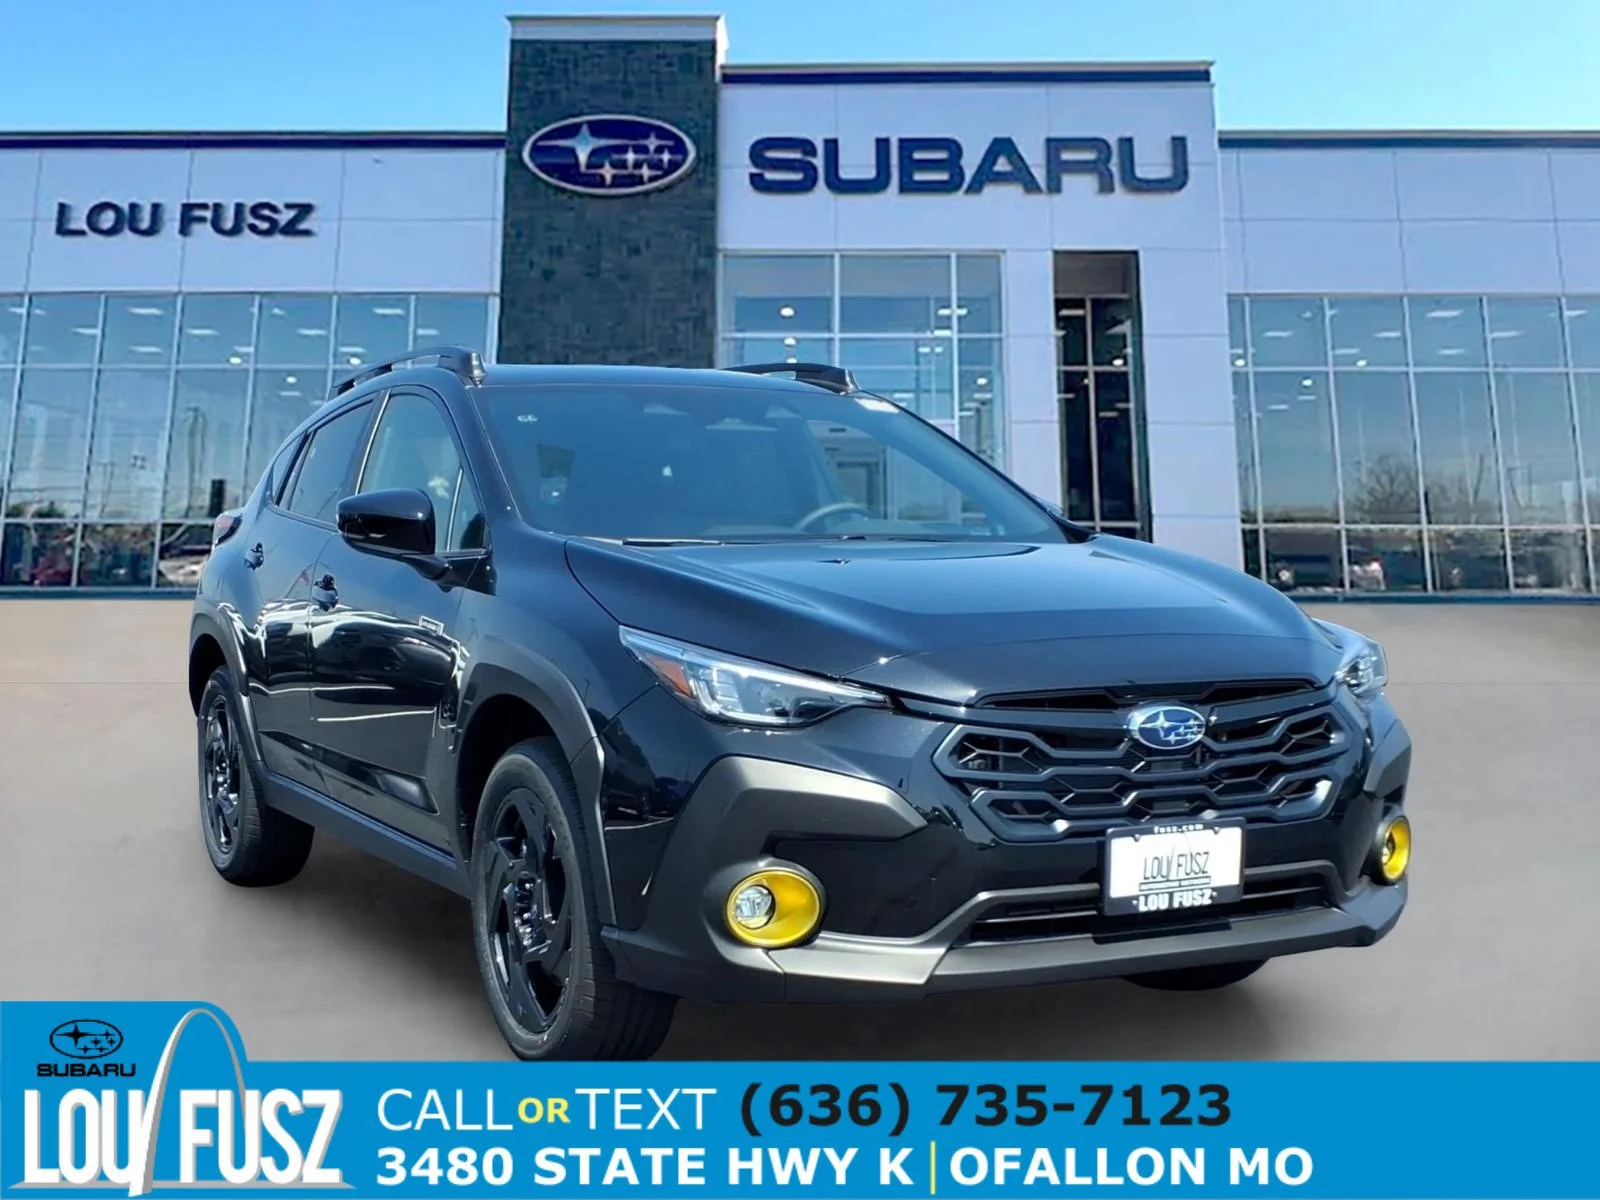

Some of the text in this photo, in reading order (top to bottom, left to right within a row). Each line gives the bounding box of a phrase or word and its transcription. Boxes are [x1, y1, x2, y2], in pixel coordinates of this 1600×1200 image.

[748, 136, 1190, 195] SUBARU
[55, 201, 316, 237] LOU FUSZ
[1153, 823, 1204, 835] fusz.com
[1143, 851, 1211, 881] LOU FUSZ
[1138, 888, 1213, 912] LOU FUSZ
